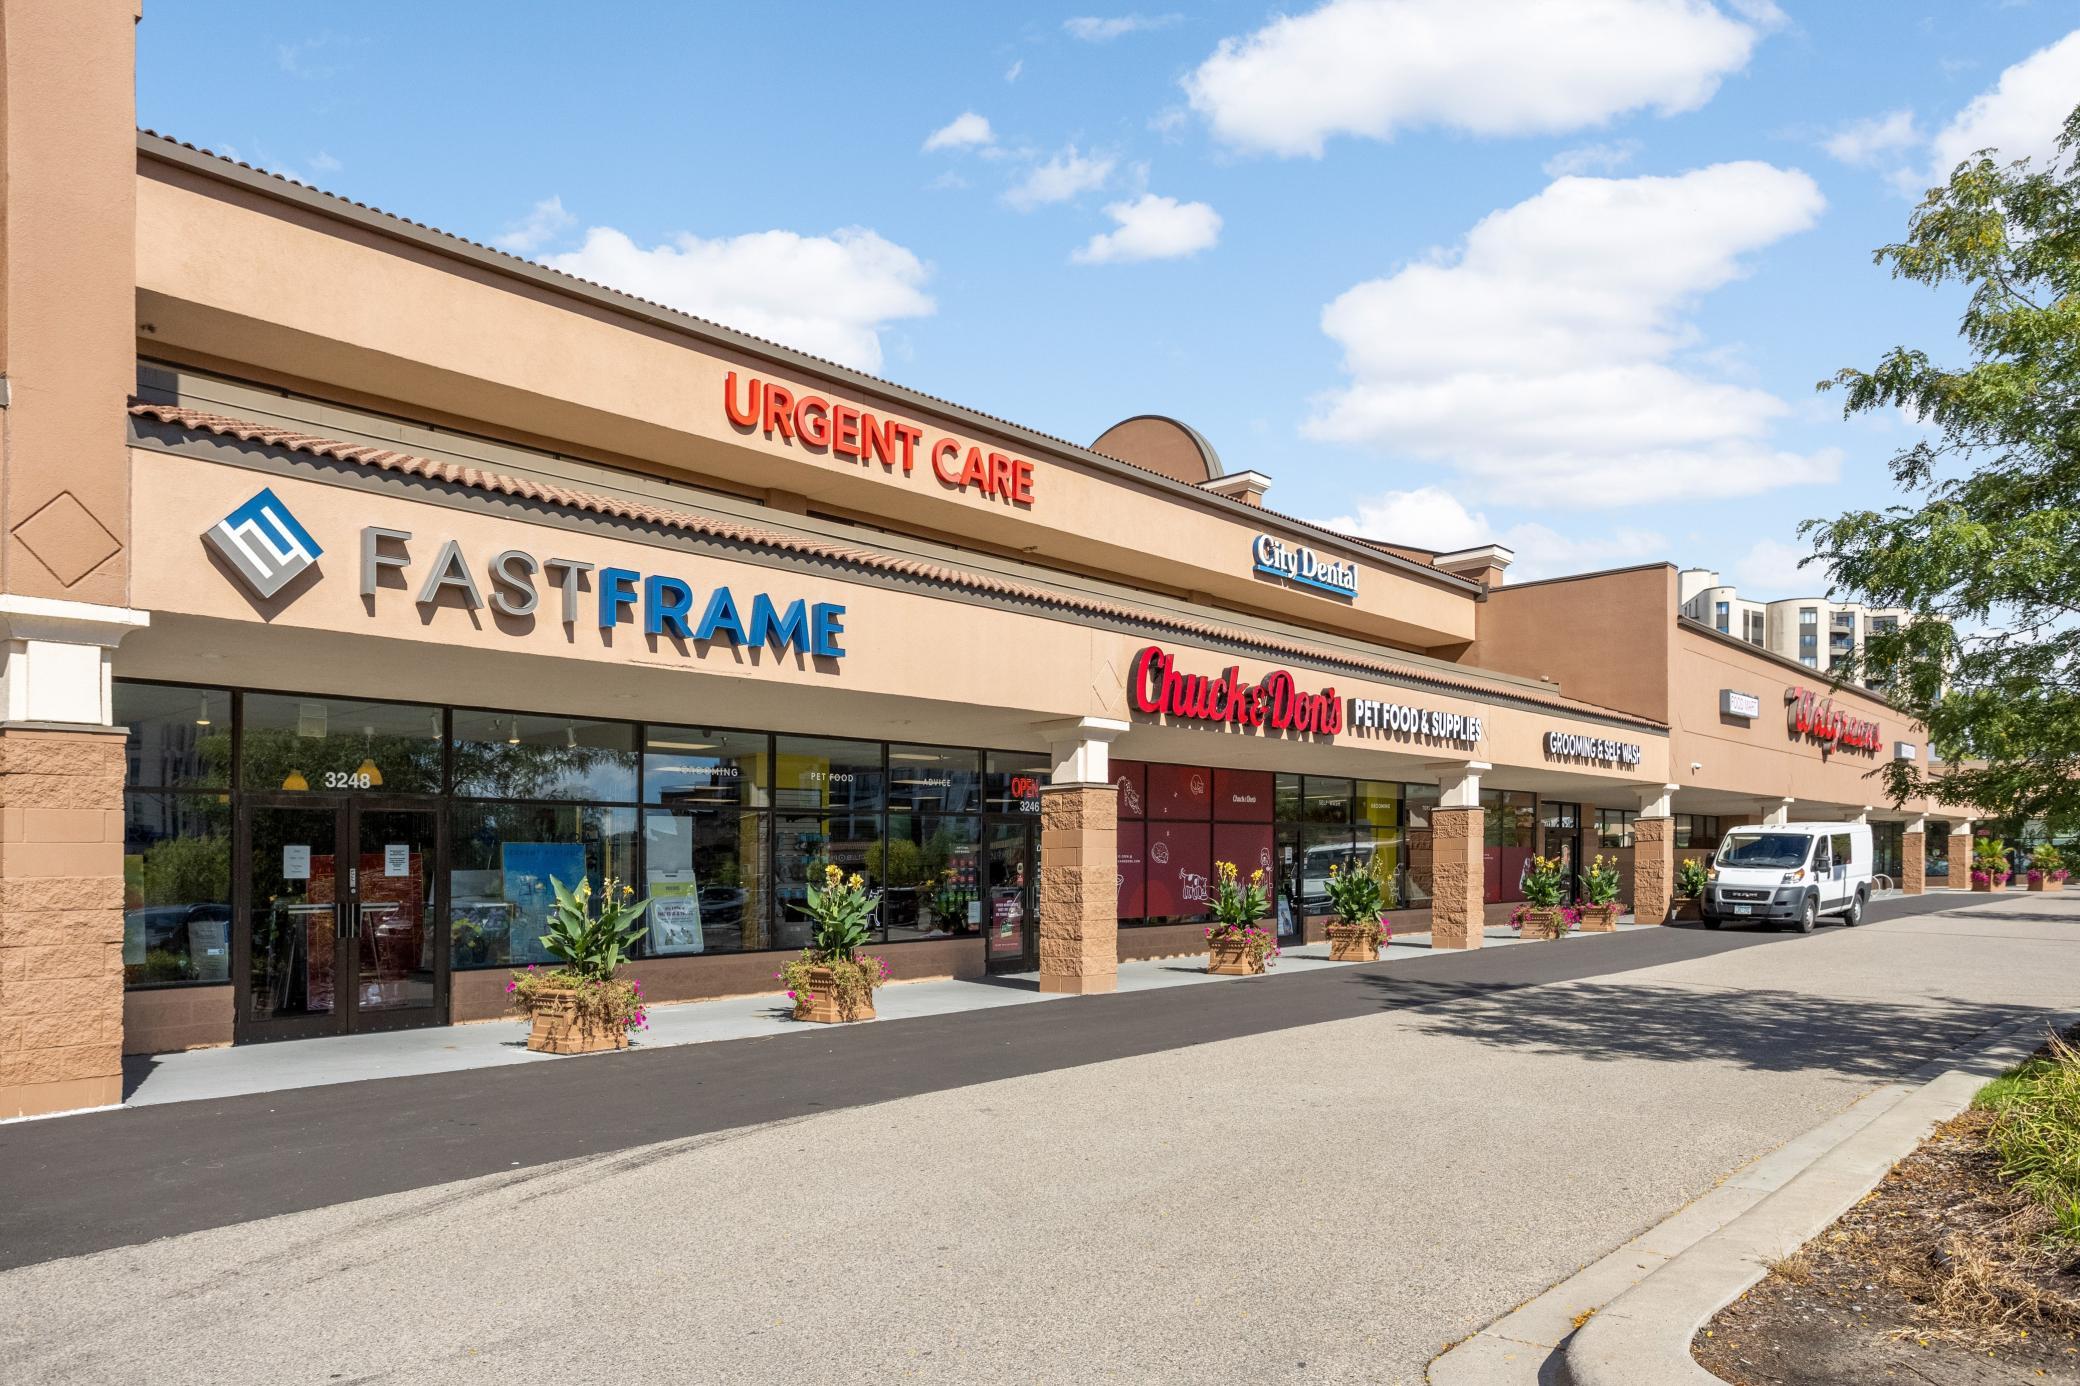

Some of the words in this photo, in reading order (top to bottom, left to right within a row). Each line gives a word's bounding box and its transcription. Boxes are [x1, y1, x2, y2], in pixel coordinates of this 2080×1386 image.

[725, 371, 923, 472] URGENT
[932, 438, 1035, 504] CARE
[1255, 534, 1298, 579] City
[1299, 547, 1359, 591] Dental
[360, 526, 847, 658] FASTFRAME
[1131, 646, 1249, 725] Chuck
[1267, 670, 1342, 735] Don's
[1354, 698, 1382, 727] PET
[1382, 703, 1419, 733] FOOD
[1421, 709, 1430, 735] &
[1432, 711, 1481, 742] SUPPLIES
[1549, 731, 1596, 758] GROOMING
[1597, 739, 1604, 759] &
[1604, 740, 1621, 762] SELF
[1621, 743, 1640, 765] WASH
[325, 771, 371, 789] 3248
[680, 765, 738, 777] GROOMING
[811, 772, 826, 781] PET
[829, 773, 854, 782] FOOD
[922, 778, 951, 787] ADVICE
[1011, 777, 1039, 798] OPEN
[1020, 801, 1040, 812] 3246
